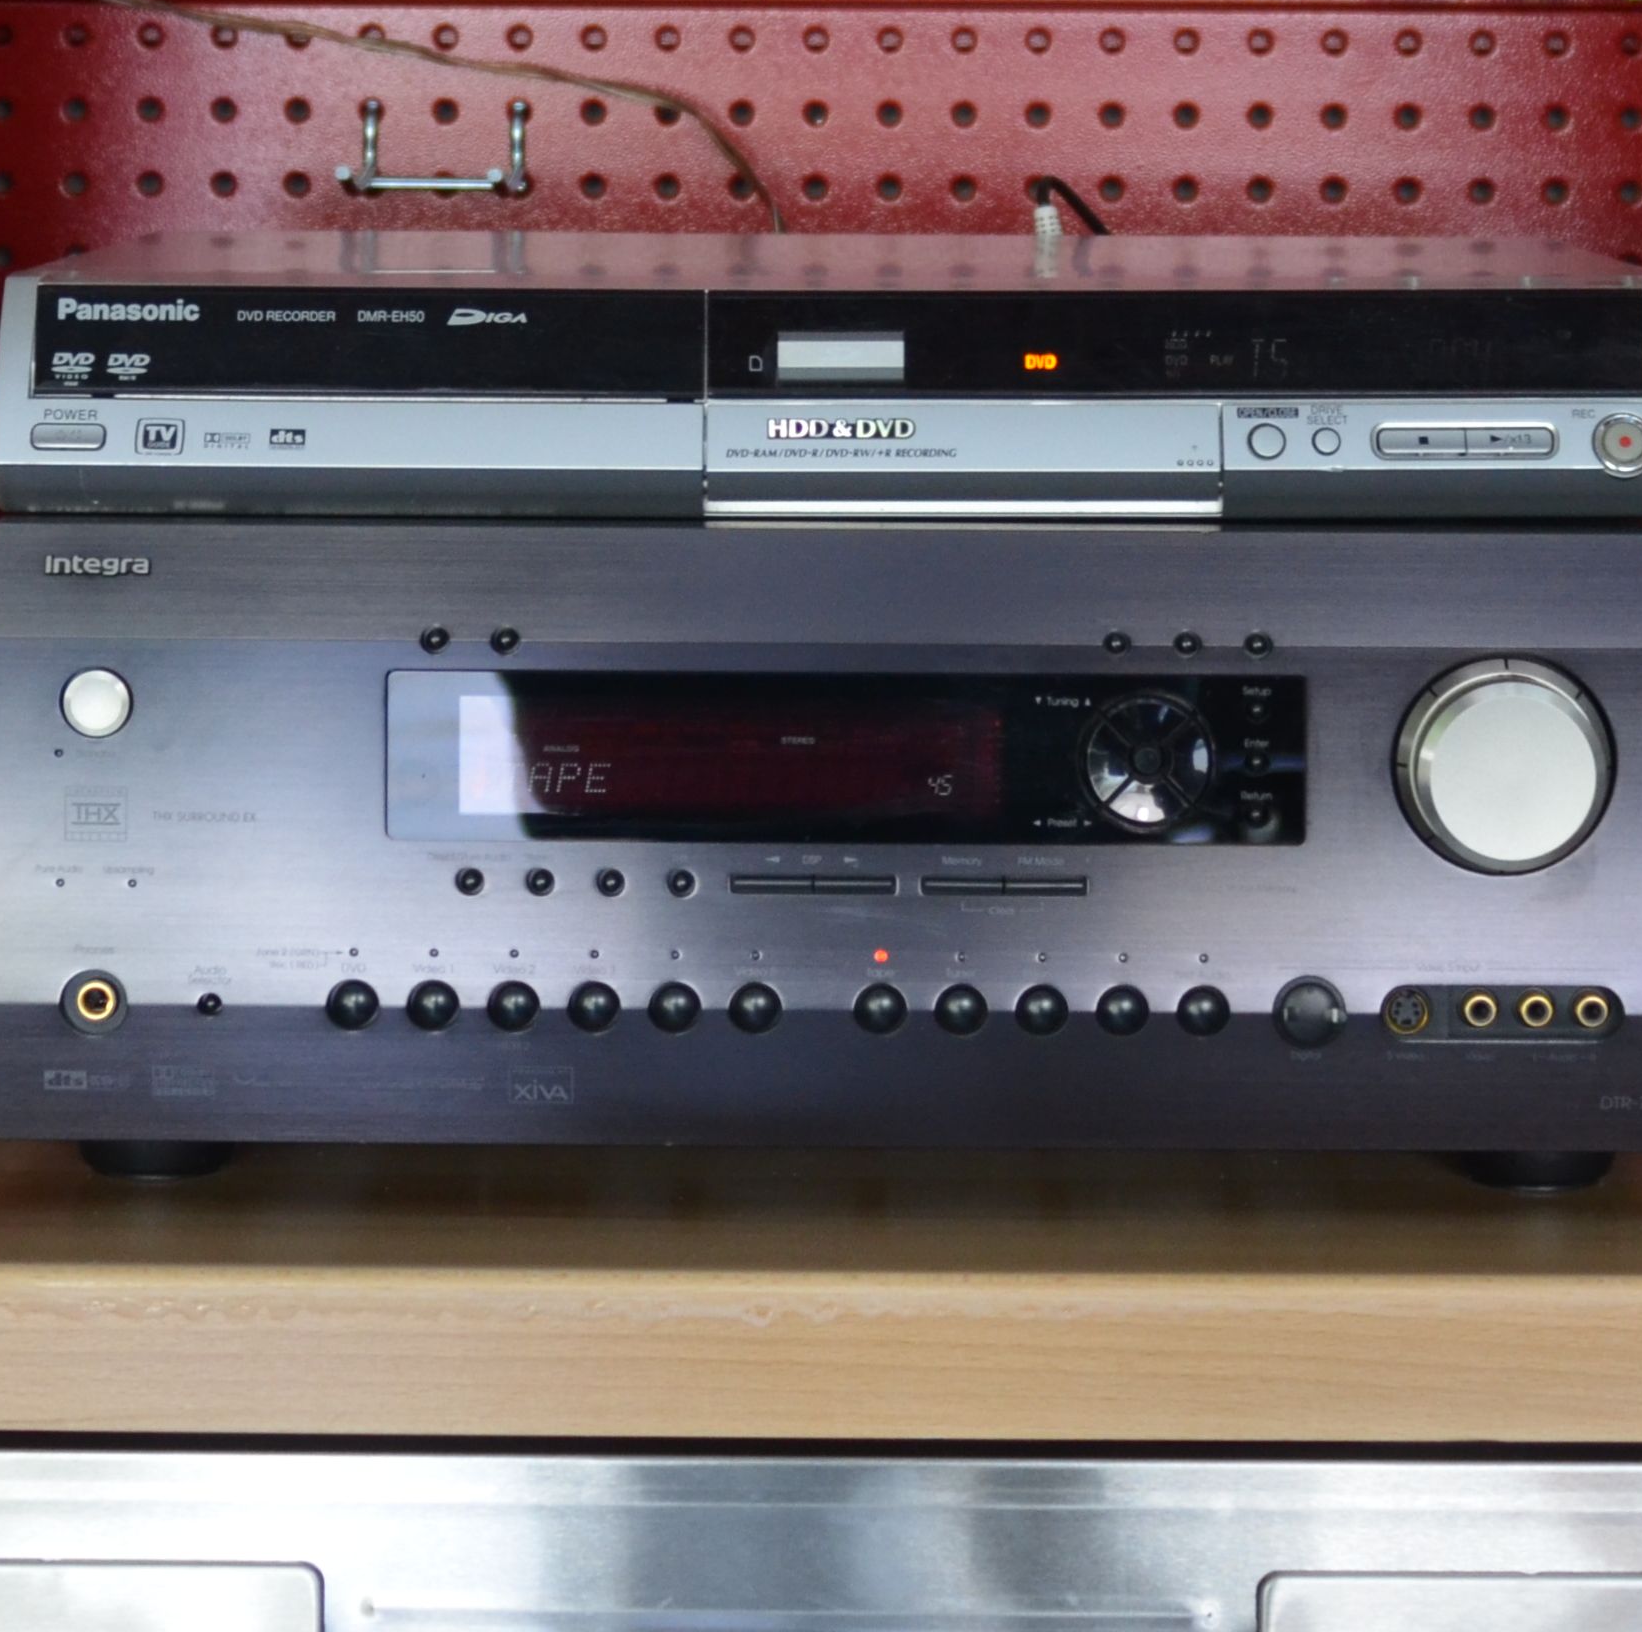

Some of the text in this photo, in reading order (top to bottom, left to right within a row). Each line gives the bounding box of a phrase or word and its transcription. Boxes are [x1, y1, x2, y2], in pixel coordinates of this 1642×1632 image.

[57, 297, 200, 321] Panasonic
[237, 310, 336, 322] DVD RECORDER
[357, 310, 425, 323] DMR-EH50
[446, 308, 528, 326] DIGA
[52, 352, 95, 366] DVD
[107, 354, 151, 368] DVD
[1024, 354, 1057, 369] DVD
[43, 408, 98, 421] POWER
[1238, 407, 1299, 418] OPEN/CLOSE
[1310, 404, 1343, 415] DRIVE
[1572, 408, 1596, 419] REC
[1307, 415, 1347, 425] SELECT
[146, 425, 176, 442] TV
[767, 419, 828, 439] HDD
[855, 419, 916, 439] DVD
[271, 430, 304, 444] dts
[895, 449, 957, 458] RECORDING
[44, 554, 150, 576] Integra
[1242, 686, 1272, 697] Setup
[1046, 696, 1079, 708] Tuning
[1244, 739, 1269, 749] Enter
[1241, 790, 1272, 802] Return
[74, 806, 120, 822] THX
[1047, 817, 1077, 829] Preset
